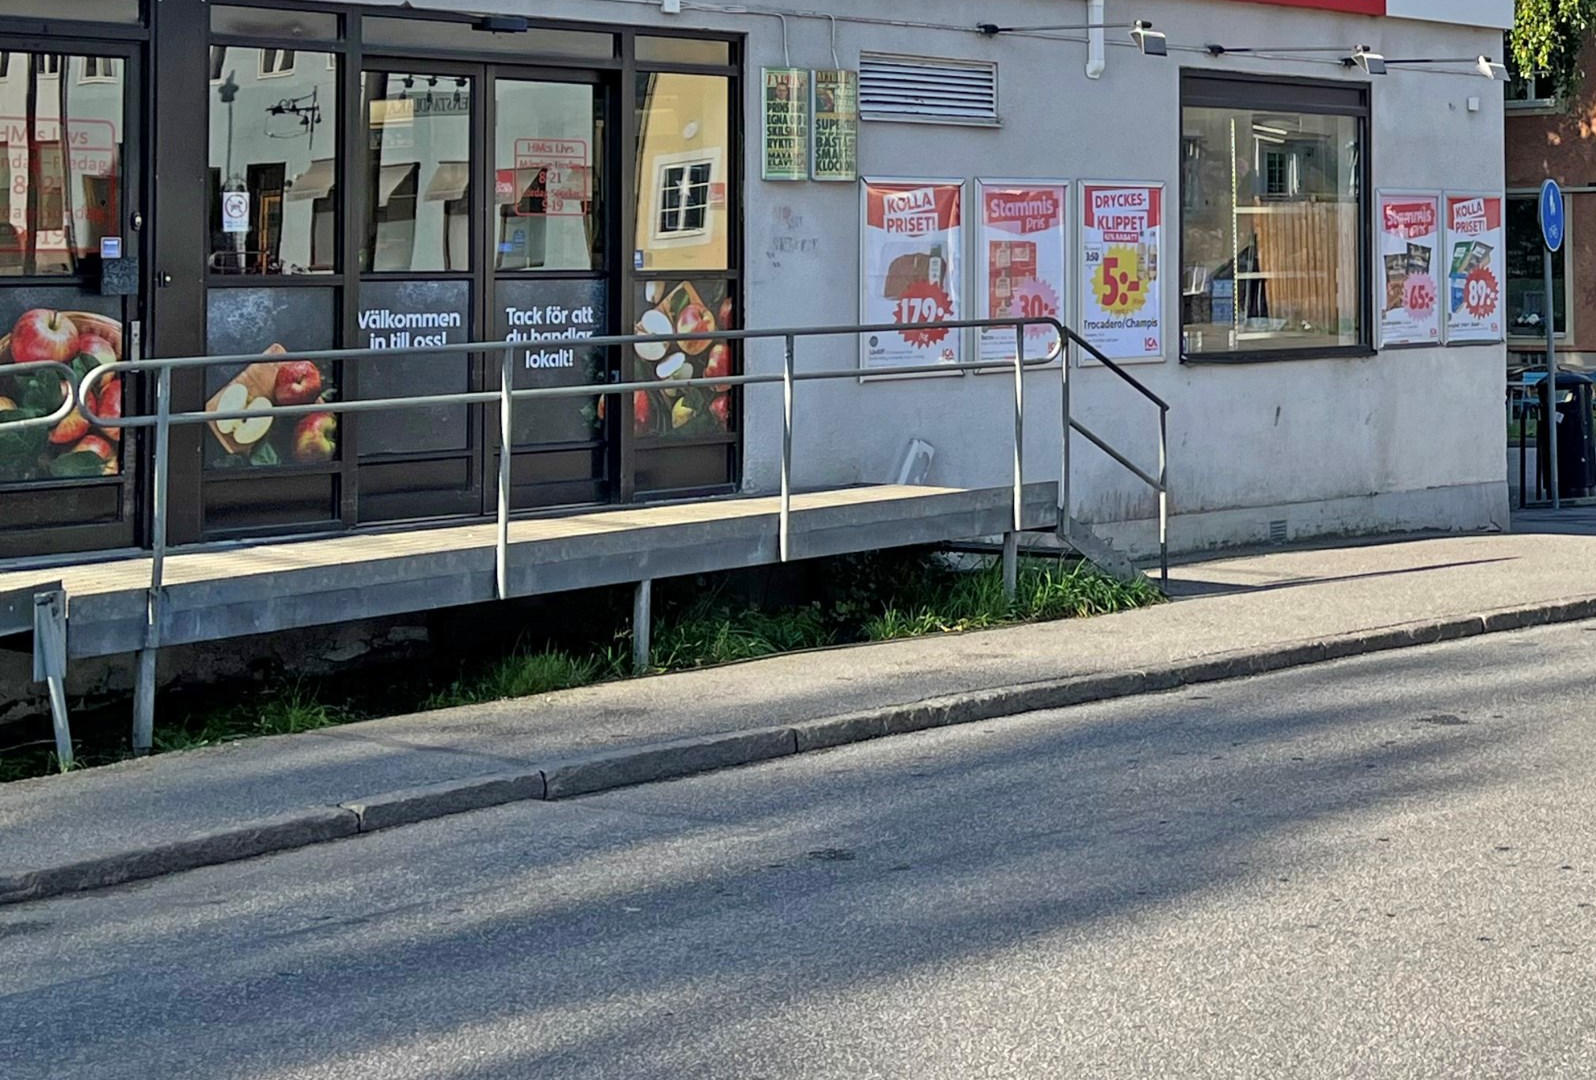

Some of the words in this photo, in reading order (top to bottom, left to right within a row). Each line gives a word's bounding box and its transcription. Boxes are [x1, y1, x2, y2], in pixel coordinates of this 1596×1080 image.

[887, 192, 933, 214] KOLLA
[990, 196, 1054, 218] Stammis
[1095, 193, 1147, 208] DRYCKES-
[1455, 201, 1483, 218] KOLLA
[886, 216, 937, 233] PRISET!
[1025, 217, 1045, 233] Pris
[1097, 216, 1144, 230] KLIPPET
[1455, 220, 1487, 233] PRISET!
[1101, 257, 1140, 306] 5:-
[358, 309, 461, 329] Välkommen
[505, 306, 542, 325] Tack
[546, 305, 568, 324] för
[571, 306, 594, 324] att
[370, 332, 386, 350] in
[390, 332, 410, 349] till
[525, 348, 574, 368] lokalt!
